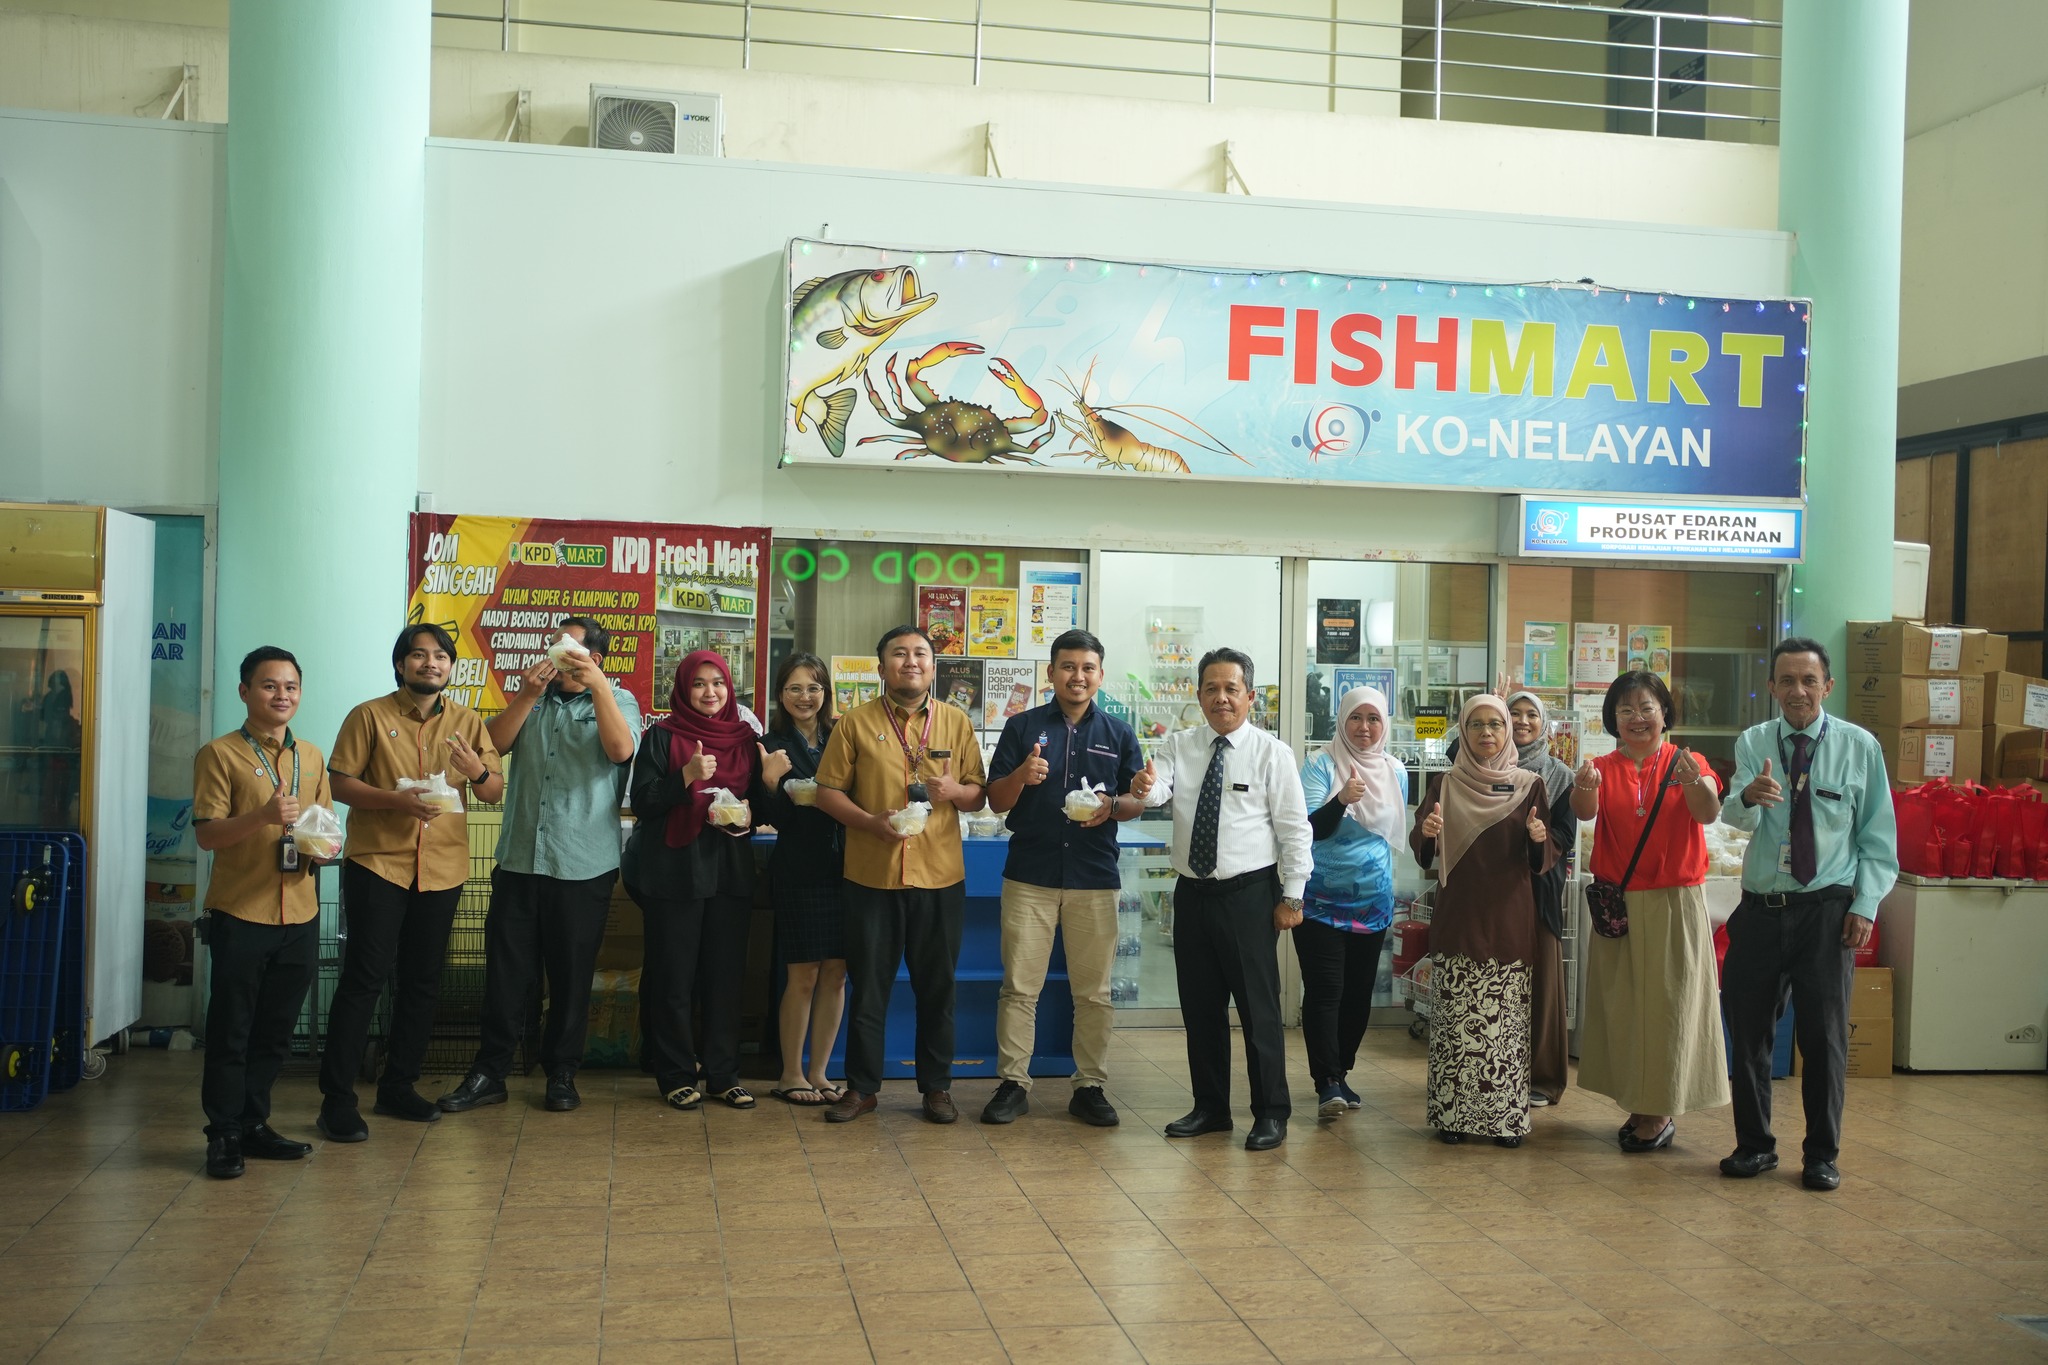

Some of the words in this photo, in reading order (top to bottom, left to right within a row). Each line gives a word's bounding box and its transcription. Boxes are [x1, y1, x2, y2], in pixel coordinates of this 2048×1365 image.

[1228, 304, 1785, 409] FISHMART
[1397, 414, 1711, 467] KO-NELAYAN
[1616, 512, 1676, 526] PUSAT
[1683, 514, 1757, 528] EDARAN
[1590, 526, 1668, 540] PRODUK
[1674, 529, 1782, 543] PERIKANAN
[423, 532, 459, 562] JOM
[525, 546, 551, 561] KPD
[567, 547, 603, 563] MART
[1672, 545, 1708, 553] PERIKANAN
[612, 536, 650, 574] KPD
[656, 538, 708, 576] Fresh
[714, 540, 759, 577] Mart
[422, 564, 498, 596] SINGGAH
[501, 588, 530, 605] AYAM
[530, 589, 561, 607] SUPER
[561, 590, 571, 607] &
[572, 590, 618, 609] KAMPUNG
[620, 592, 640, 609] KPD
[676, 590, 705, 608] KPD
[720, 597, 752, 613] MART
[480, 609, 509, 627] MADU
[510, 611, 549, 629] BORNEO
[637, 615, 657, 632] KPD
[490, 632, 542, 650] CENDAWAN
[621, 636, 639, 653] ZHI
[494, 652, 521, 670] BUAH
[835, 672, 859, 680] BATANG
[987, 667, 1033, 677] BABUPOP
[987, 674, 1014, 684] popia
[503, 675, 522, 692] AIS
[987, 690, 1007, 699] mini
[1104, 704, 1133, 714] CUTI
[1137, 705, 1172, 714] UMUM
[1416, 726, 1445, 735] QRPAY
